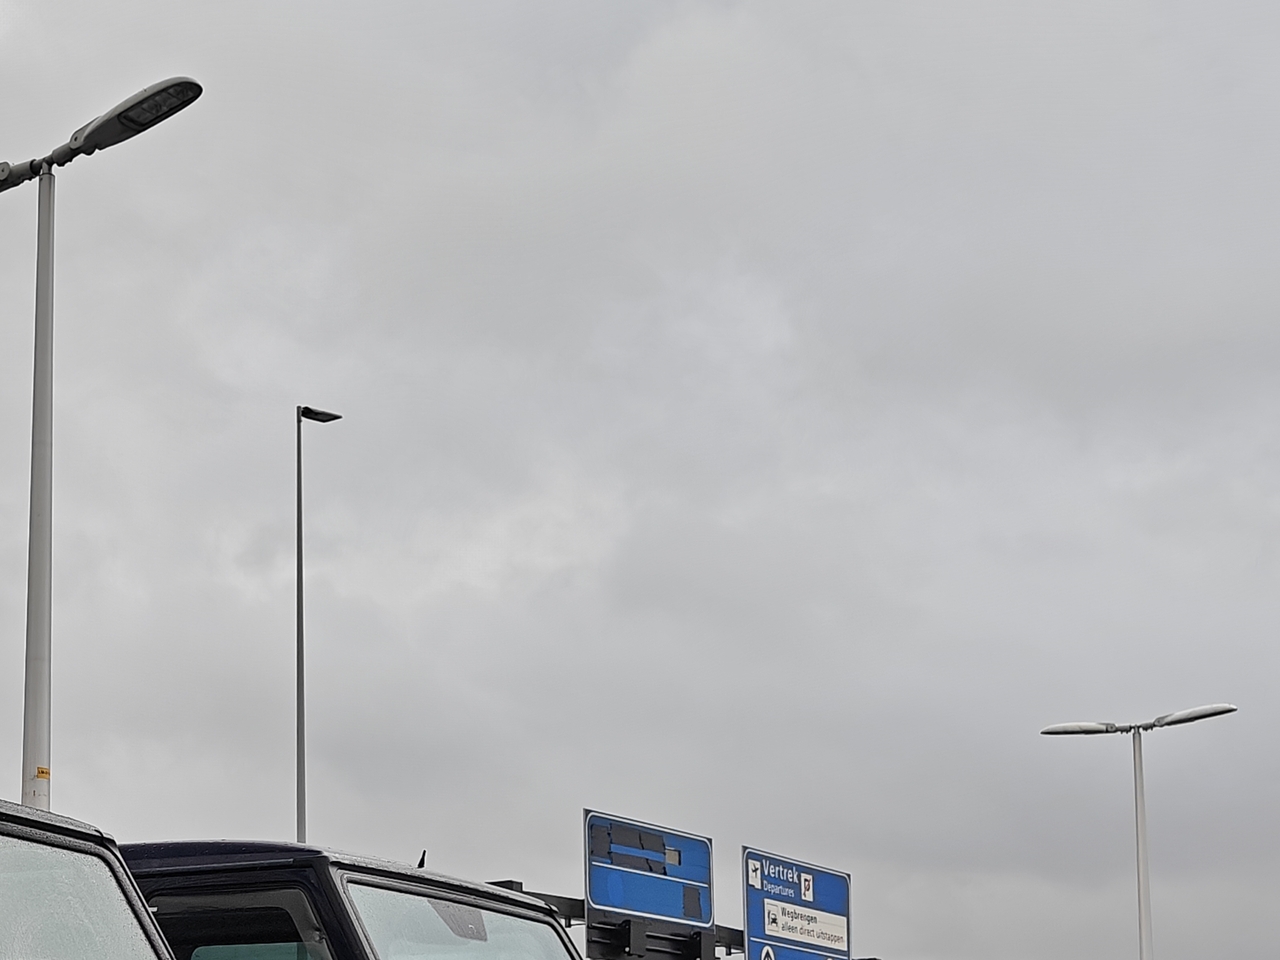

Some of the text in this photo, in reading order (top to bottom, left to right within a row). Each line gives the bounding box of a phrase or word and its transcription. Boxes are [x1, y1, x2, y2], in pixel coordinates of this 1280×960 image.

[762, 859, 799, 884] Vertrek
[763, 881, 795, 898] Departures
[781, 907, 818, 925] Wegbrengen
[781, 921, 844, 944] alleen direct uitstappen
